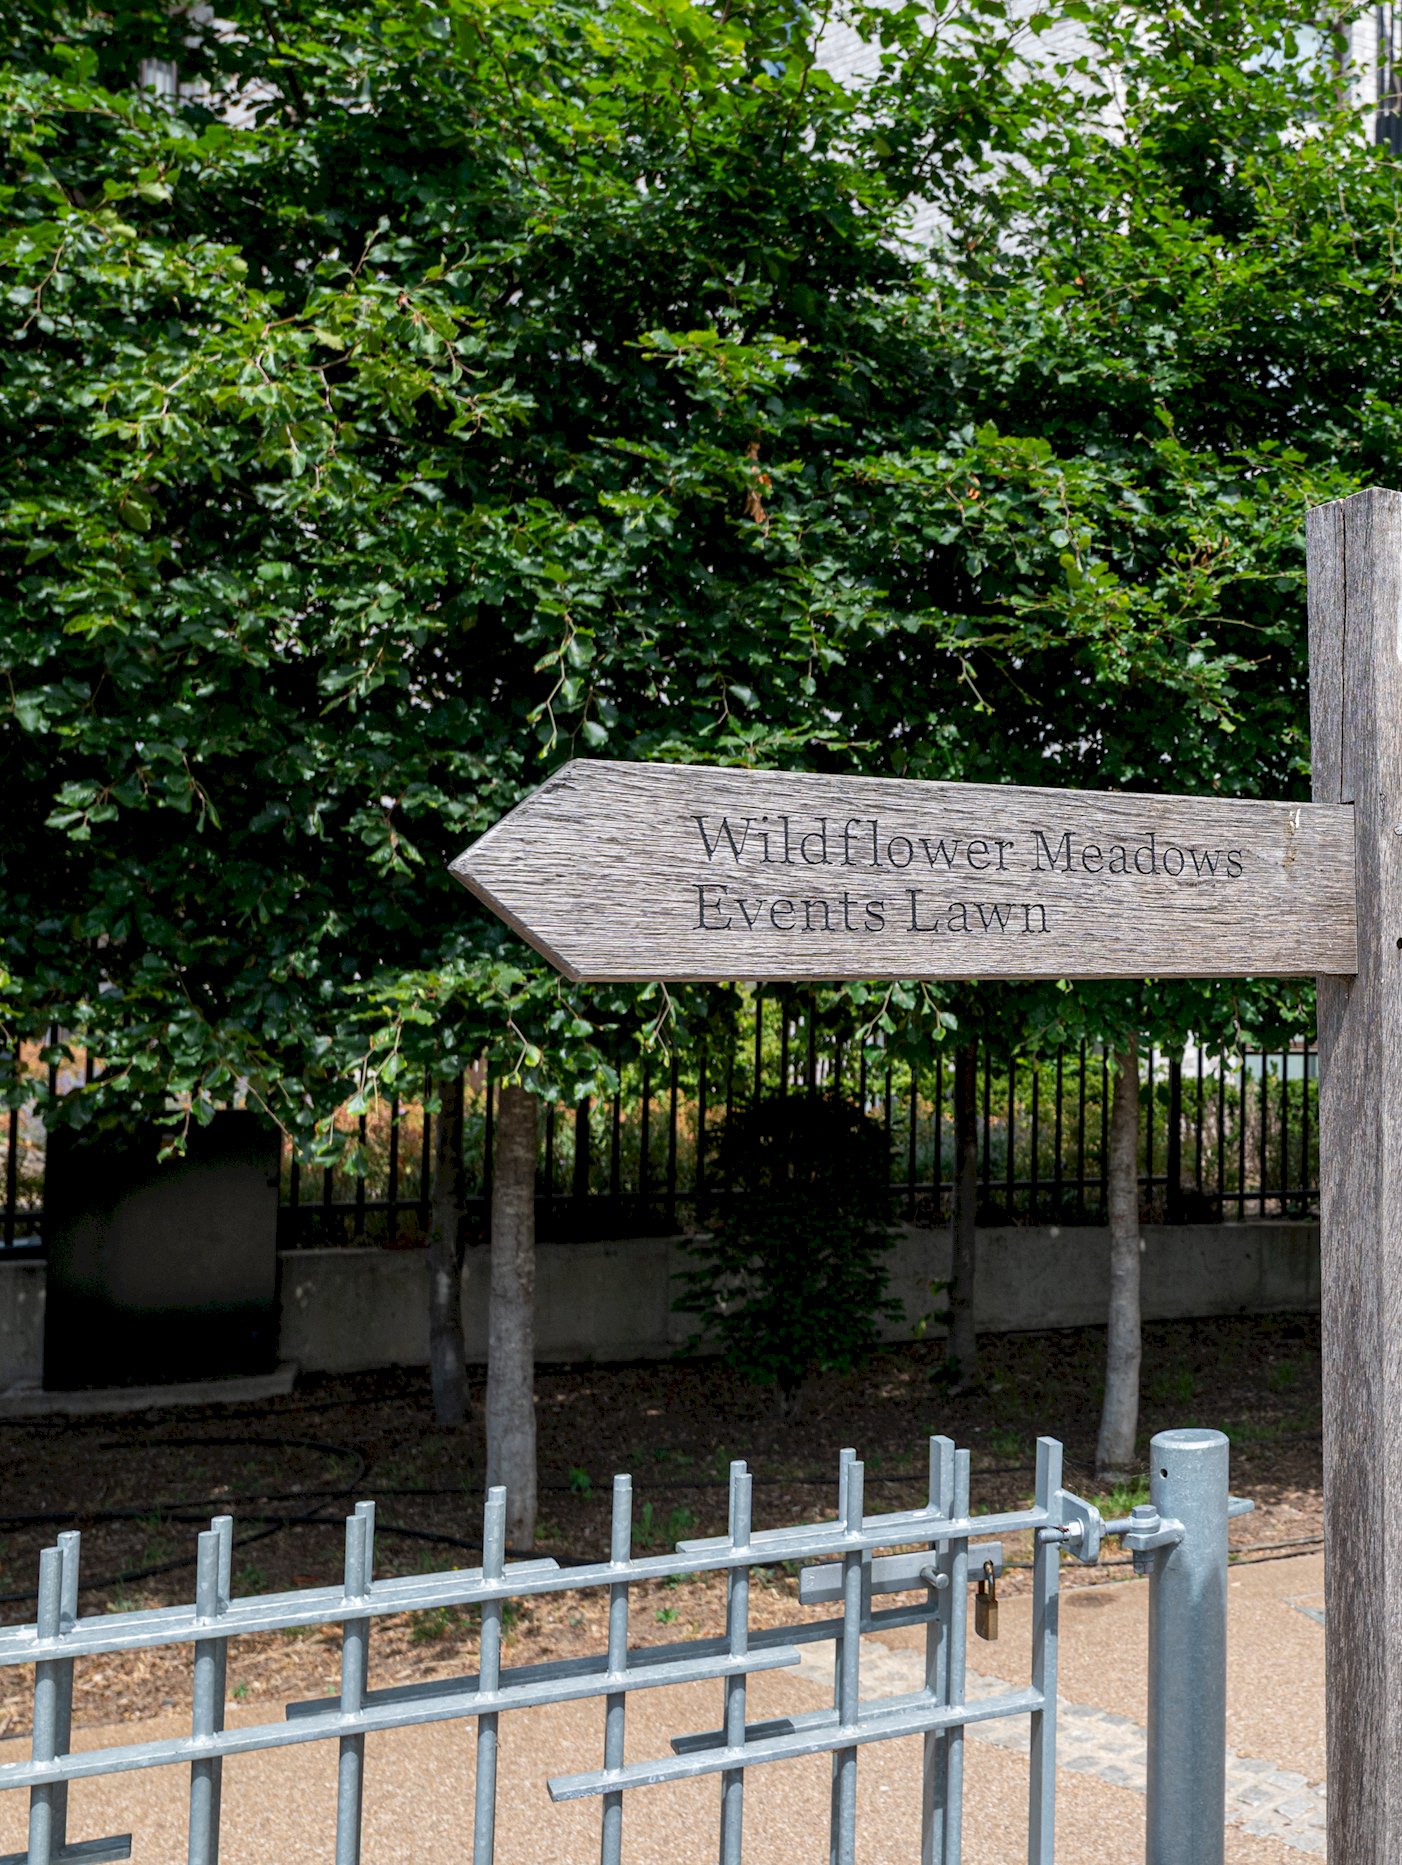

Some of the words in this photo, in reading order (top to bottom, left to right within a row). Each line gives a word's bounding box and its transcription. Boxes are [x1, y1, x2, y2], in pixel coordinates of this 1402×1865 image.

[691, 815, 1014, 872] Wildflower
[1030, 830, 1244, 879] Meadows
[692, 883, 886, 933] Events
[906, 889, 1052, 934] Lawn
